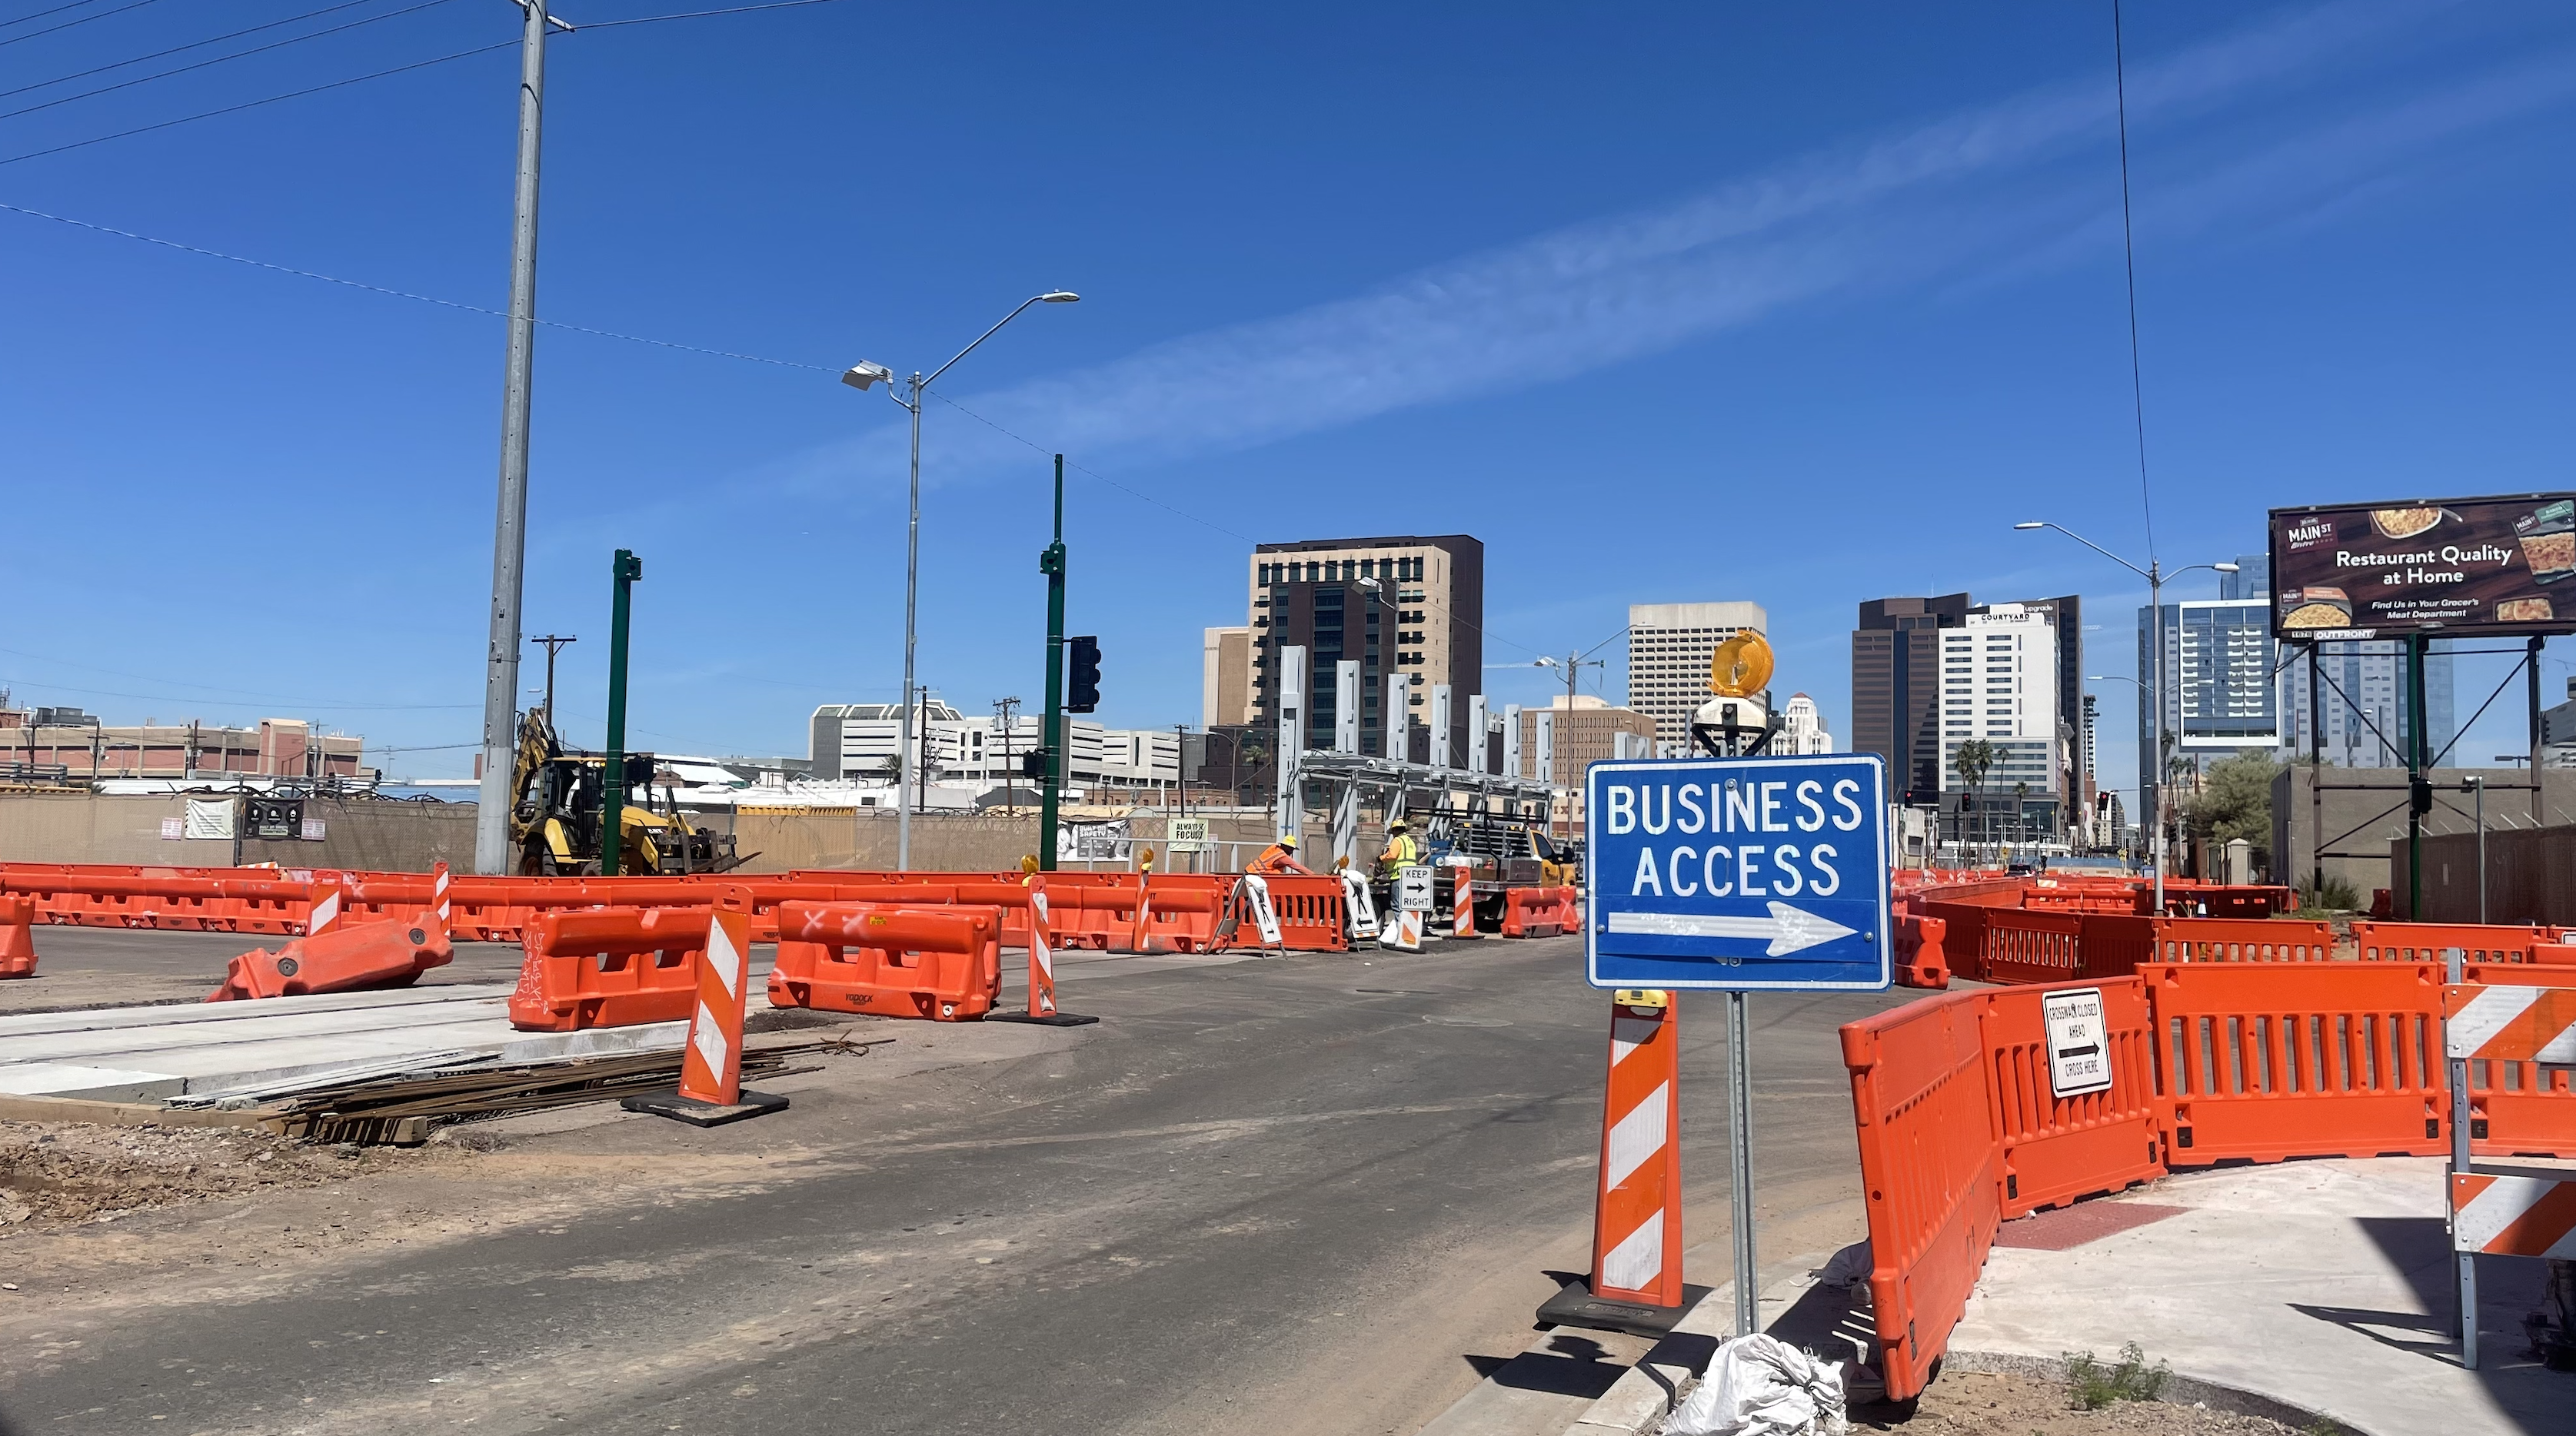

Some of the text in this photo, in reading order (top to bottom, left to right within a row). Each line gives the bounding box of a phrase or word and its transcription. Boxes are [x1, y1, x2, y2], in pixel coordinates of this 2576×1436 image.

[2288, 524, 2331, 542] MAIN ST
[2336, 544, 2513, 567] Restaurant Quality
[2383, 567, 2465, 585] at Home
[2025, 604, 2053, 613] upgrade
[2371, 598, 2479, 610] Find Us in Your Grocer's
[2387, 610, 2467, 620] Meat Department
[2315, 630, 2375, 639] OUTFRONT
[1608, 779, 1862, 836] BUSINESS
[1406, 869, 1428, 879] KEEP
[1631, 844, 1840, 897] ACCESS
[1403, 897, 1429, 906] RIGHT
[846, 993, 874, 1003] YODOCK
[2078, 1003, 2098, 1018] CLOSED
[2068, 1023, 2085, 1039] AHEAD
[2065, 1059, 2098, 1077] CROSS HERE
